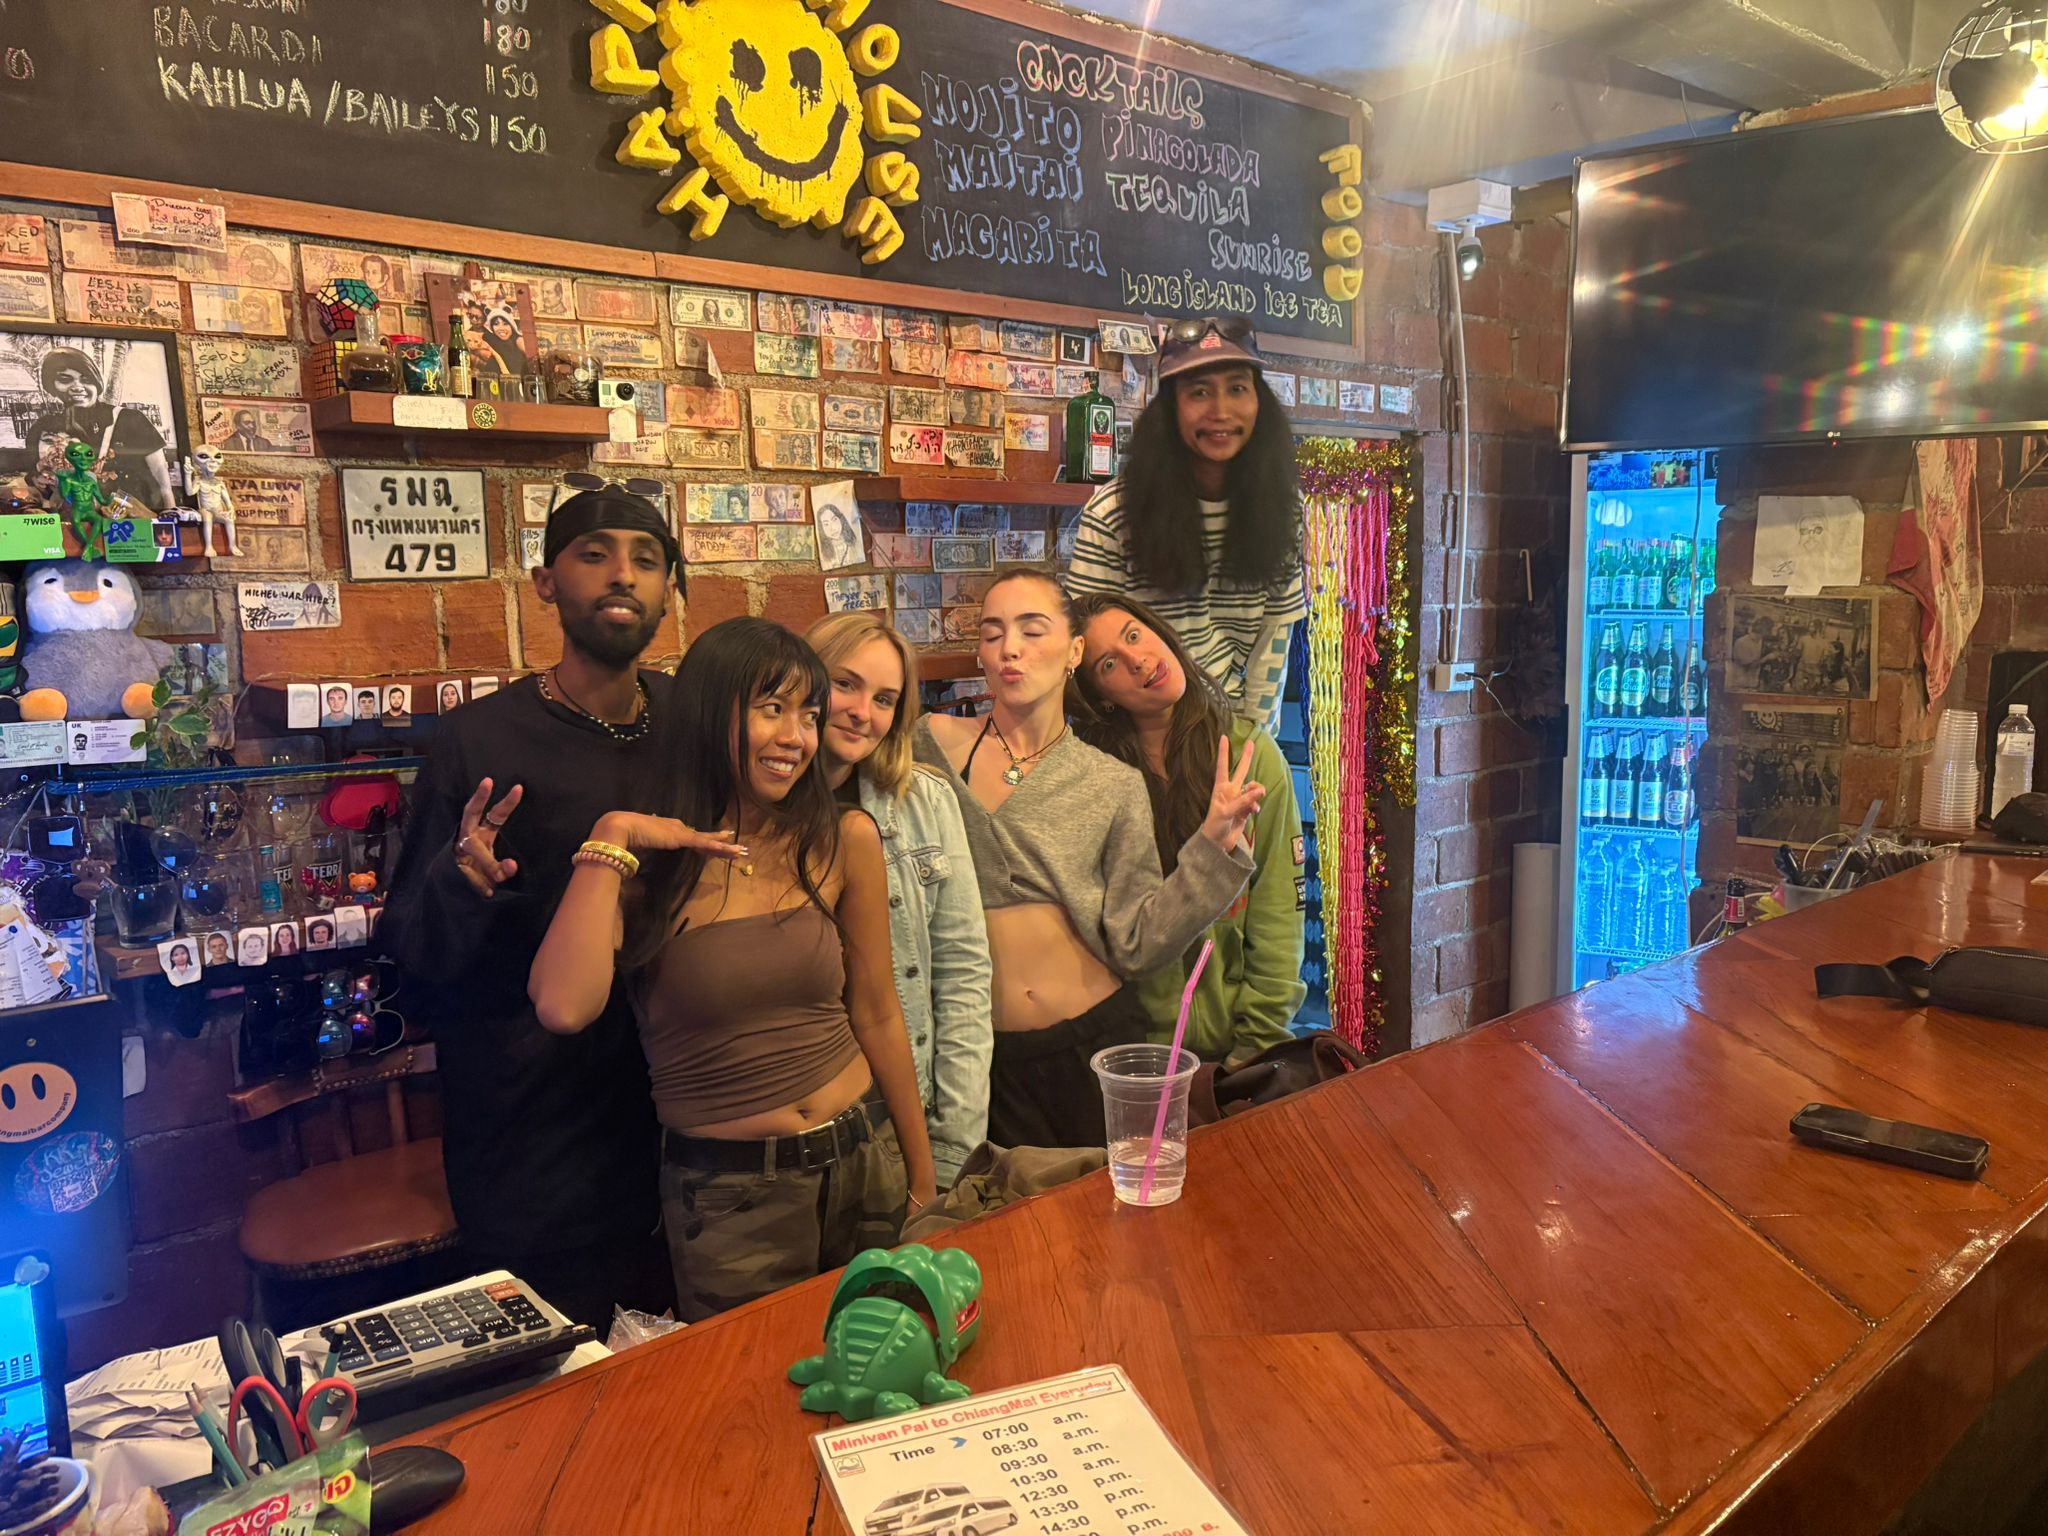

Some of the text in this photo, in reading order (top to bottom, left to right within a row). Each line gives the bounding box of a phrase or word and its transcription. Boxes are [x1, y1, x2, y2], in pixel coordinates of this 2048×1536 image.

[152, 6, 323, 67] BACARDI
[483, 17, 532, 54] 180
[485, 63, 539, 99] 150
[158, 56, 312, 119] KAHLUA
[485, 113, 548, 155] 150
[1319, 143, 1364, 302] FOOD
[89, 312, 181, 329] MURDERED
[1302, 295, 1343, 329] TEA
[755, 416, 767, 427] 20
[751, 485, 763, 497] 20
[352, 516, 481, 541] กรุงเทพมหานคร
[43, 547, 61, 555] VISA
[385, 542, 456, 573] 479
[0, 1092, 71, 1138] ngmaibarcompany
[832, 1428, 898, 1453] Minivan
[932, 1416, 949, 1430] to
[1039, 1379, 1113, 1405] Everyday
[889, 1409, 1088, 1463] Time 07:00 a.m.
[990, 1425, 1099, 1457] 08:30 a.m.
[1000, 1440, 1109, 1472] 09:30 a.m.
[1010, 1456, 1120, 1488] 10:30 a.m.
[1020, 1470, 1132, 1504] 12:30 p.m.
[1030, 1486, 1144, 1520] 13:30 p.m.
[1040, 1501, 1156, 1536] 14:30 p.m.
[1127, 1516, 1168, 1536] p.m.
